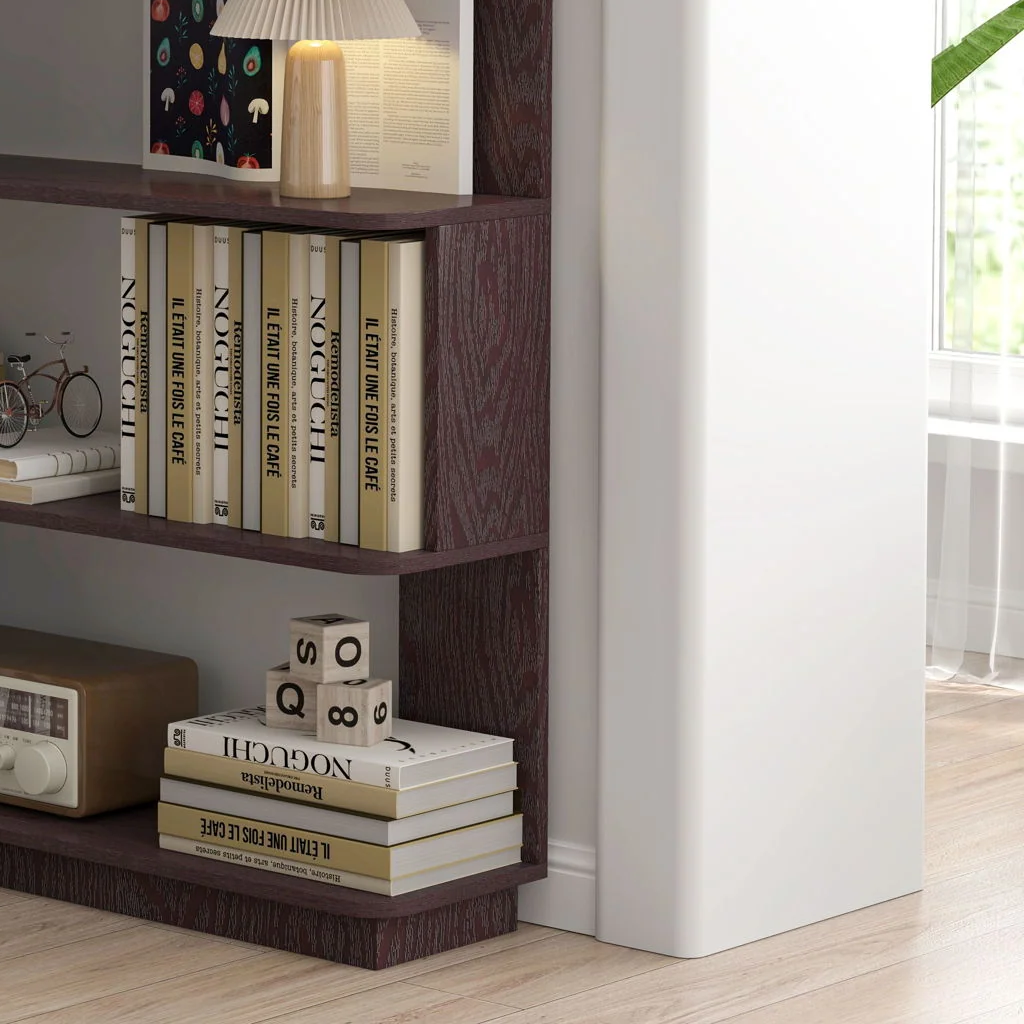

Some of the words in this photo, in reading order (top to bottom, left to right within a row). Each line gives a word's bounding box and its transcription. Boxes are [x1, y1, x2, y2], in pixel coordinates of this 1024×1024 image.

[365, 318, 378, 329] IL
[121, 278, 136, 438] NOGUCHI
[366, 334, 381, 371] ÉTAIT
[215, 287, 229, 450] NOGUCHI
[310, 295, 325, 463] NOGUCHI
[366, 375, 378, 401] UNE
[365, 405, 378, 434] FOIS
[365, 438, 378, 453] LE
[365, 458, 381, 492] CAFÉ
[297, 638, 317, 665] S
[277, 683, 305, 718] Q
[328, 706, 358, 727] 8
[223, 736, 352, 780] NOGUCHI
[241, 772, 323, 800] Remodelista
[200, 818, 225, 839] CAFÉ
[228, 823, 239, 841] LE
[243, 827, 264, 846] FOIS
[268, 832, 286, 851] UNE
[290, 837, 318, 861] ÉTAIT
[321, 843, 330, 859] IL
